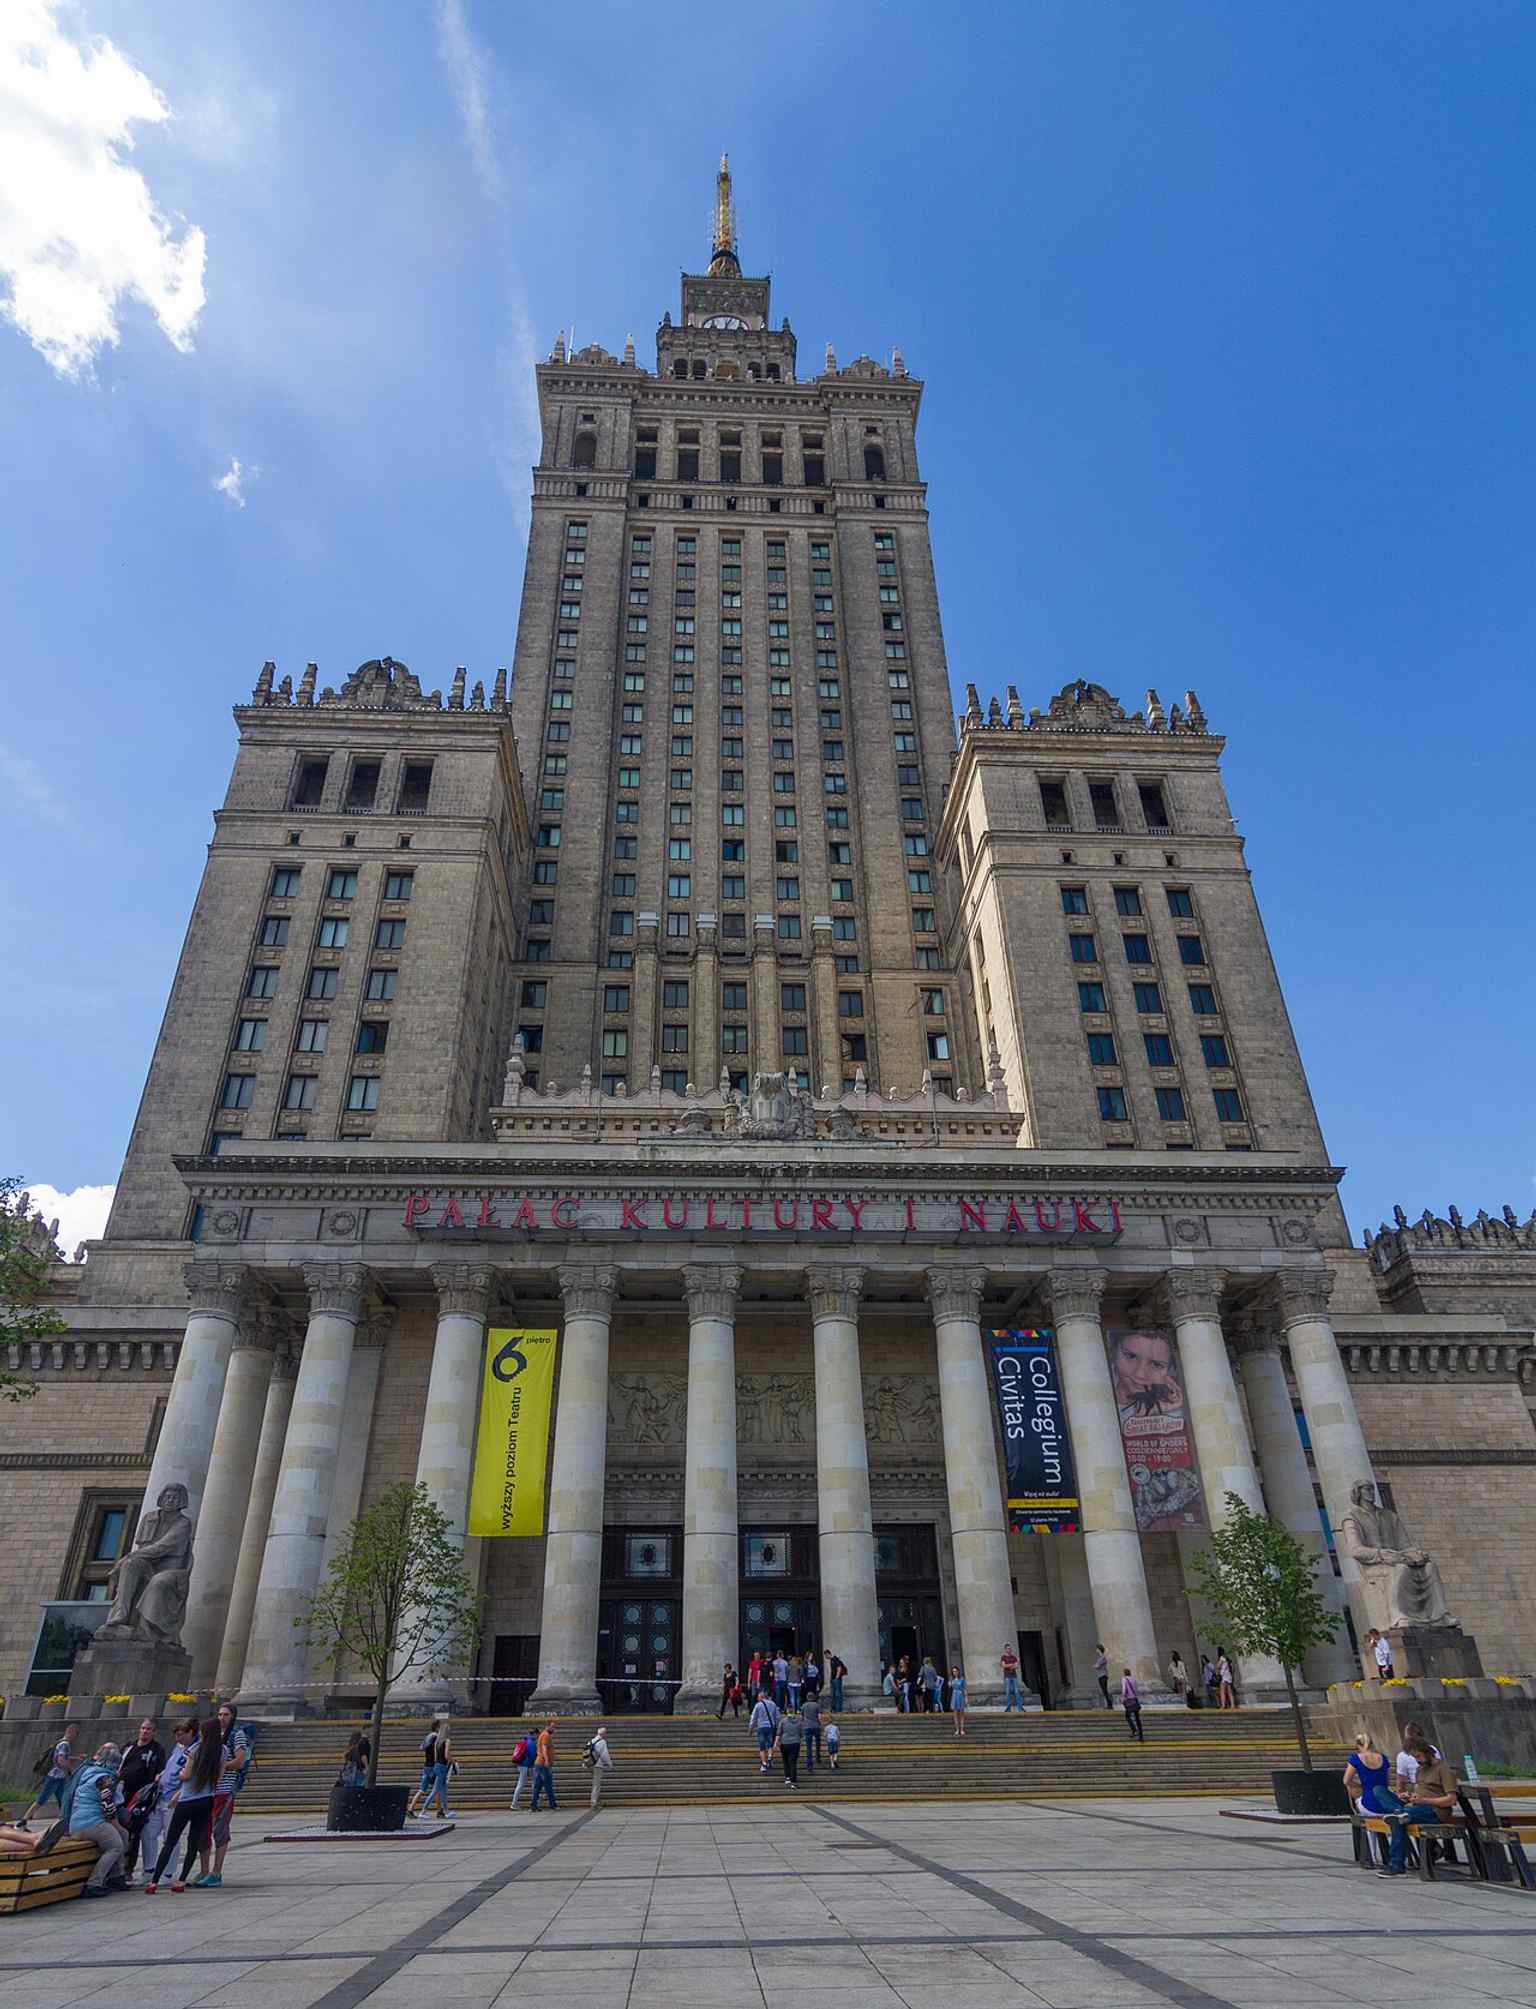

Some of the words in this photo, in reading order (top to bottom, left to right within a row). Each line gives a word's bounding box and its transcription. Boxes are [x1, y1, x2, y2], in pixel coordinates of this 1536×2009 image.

[402, 1196, 579, 1229] PAŁAC
[620, 1198, 866, 1231] KULTURY
[904, 1199, 917, 1231] I
[959, 1199, 1124, 1232] NAUKI
[491, 1336, 527, 1383] 6
[508, 1387, 522, 1427] Teatru
[997, 1356, 1025, 1439] Civitas
[1029, 1356, 1063, 1484] Collegium
[505, 1430, 518, 1478] poziom
[501, 1481, 516, 1530] wyższy
